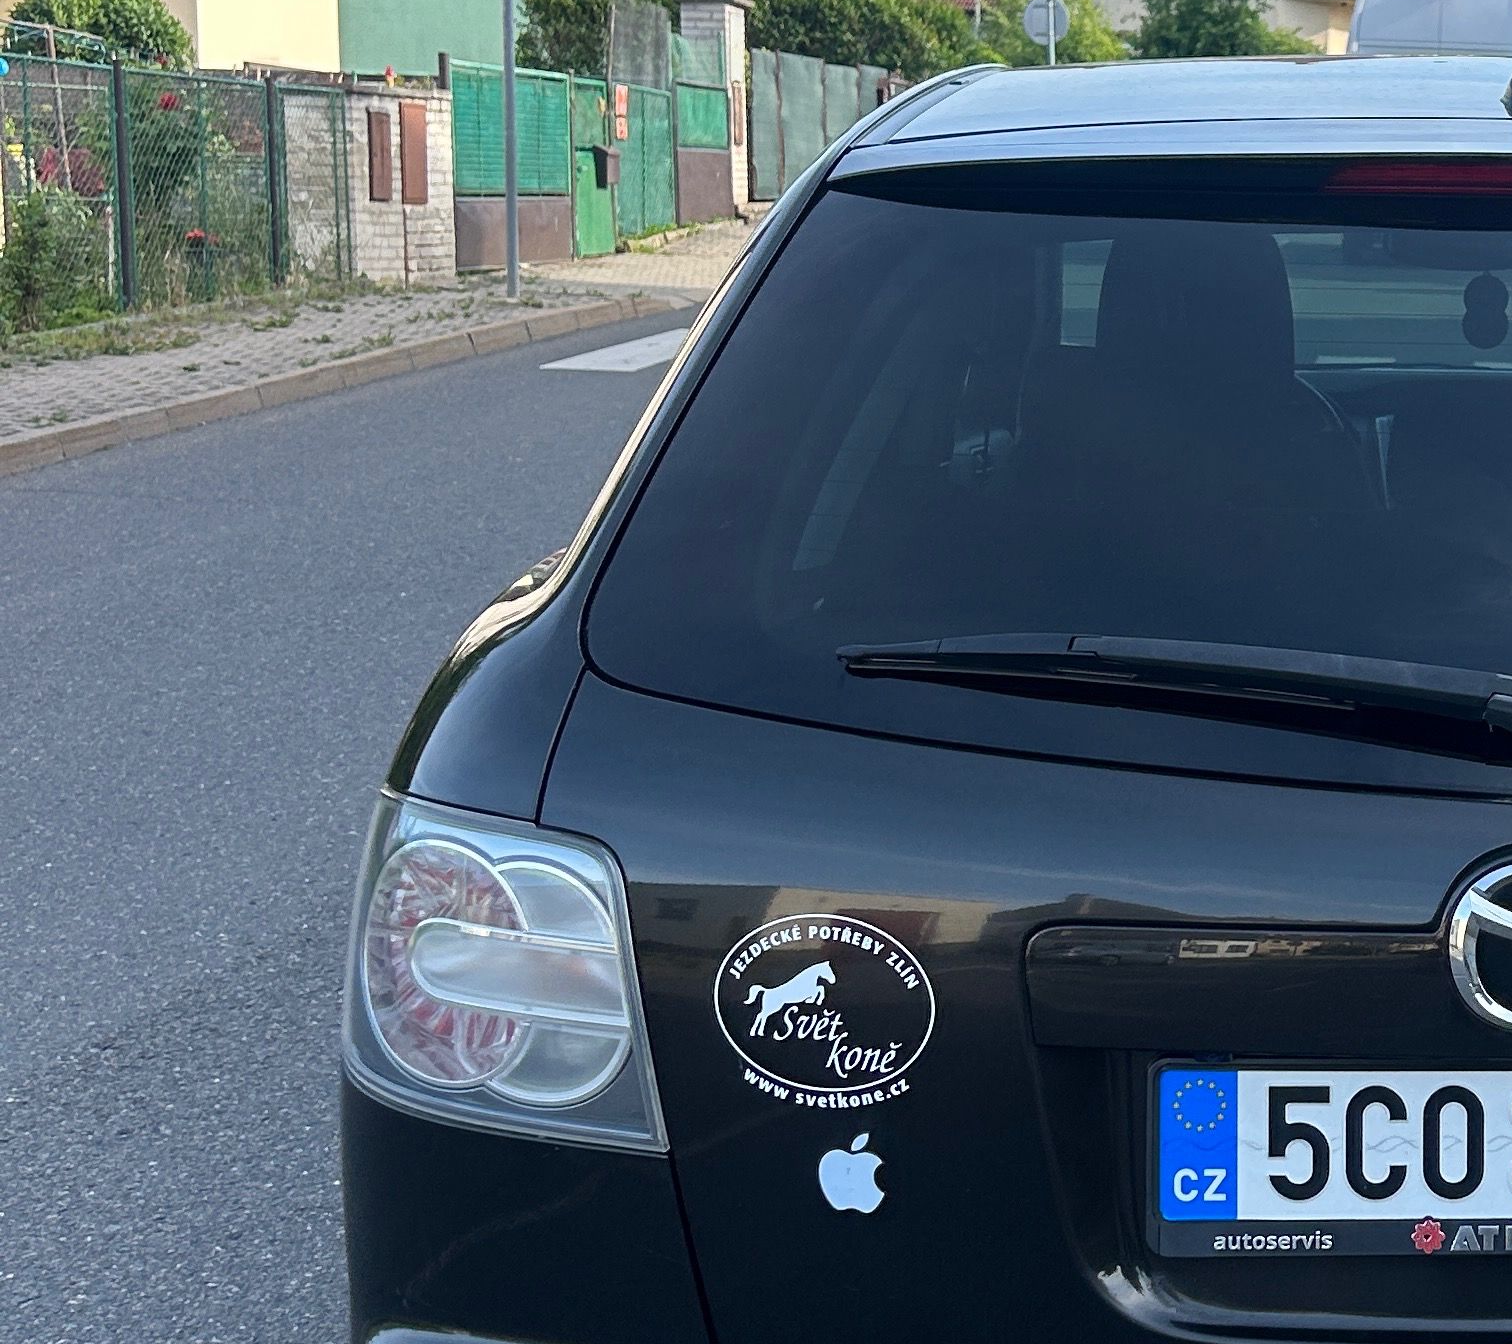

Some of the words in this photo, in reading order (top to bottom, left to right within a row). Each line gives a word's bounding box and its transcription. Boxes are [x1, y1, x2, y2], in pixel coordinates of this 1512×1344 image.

[729, 924, 802, 980] JEZDECKÉ
[808, 925, 885, 956] POTŘEBY
[885, 951, 920, 990] ZLÍN
[773, 1005, 844, 1041] Svět
[825, 1032, 903, 1079] koně
[1173, 1167, 1228, 1203] CZ
[1213, 1230, 1334, 1251] autoservis
[1450, 1225, 1500, 1253] AT
